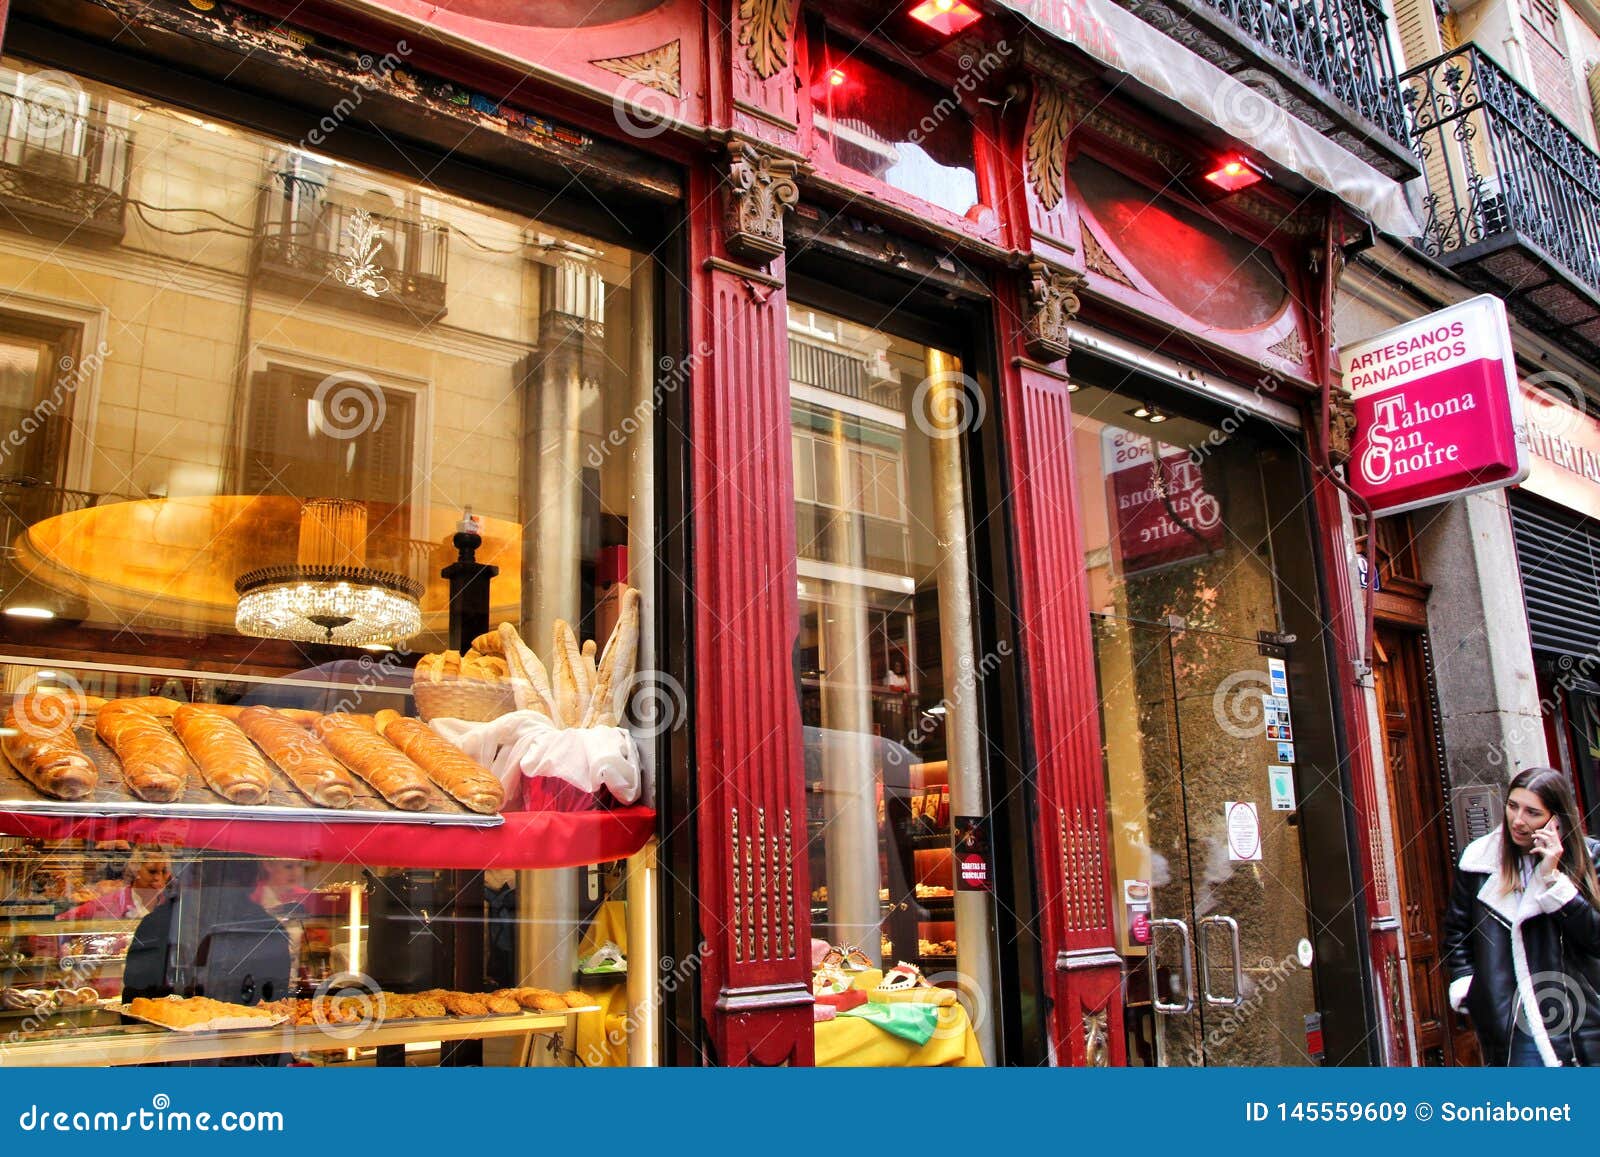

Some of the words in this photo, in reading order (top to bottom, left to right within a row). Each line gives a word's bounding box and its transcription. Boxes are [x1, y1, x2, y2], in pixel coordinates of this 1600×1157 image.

[1350, 321, 1464, 373] ARTESANOS
[1351, 341, 1466, 391] PANADEROS
[1374, 392, 1476, 433] Tahona
[1367, 424, 1424, 456] San
[1361, 442, 1458, 486] Onofre
